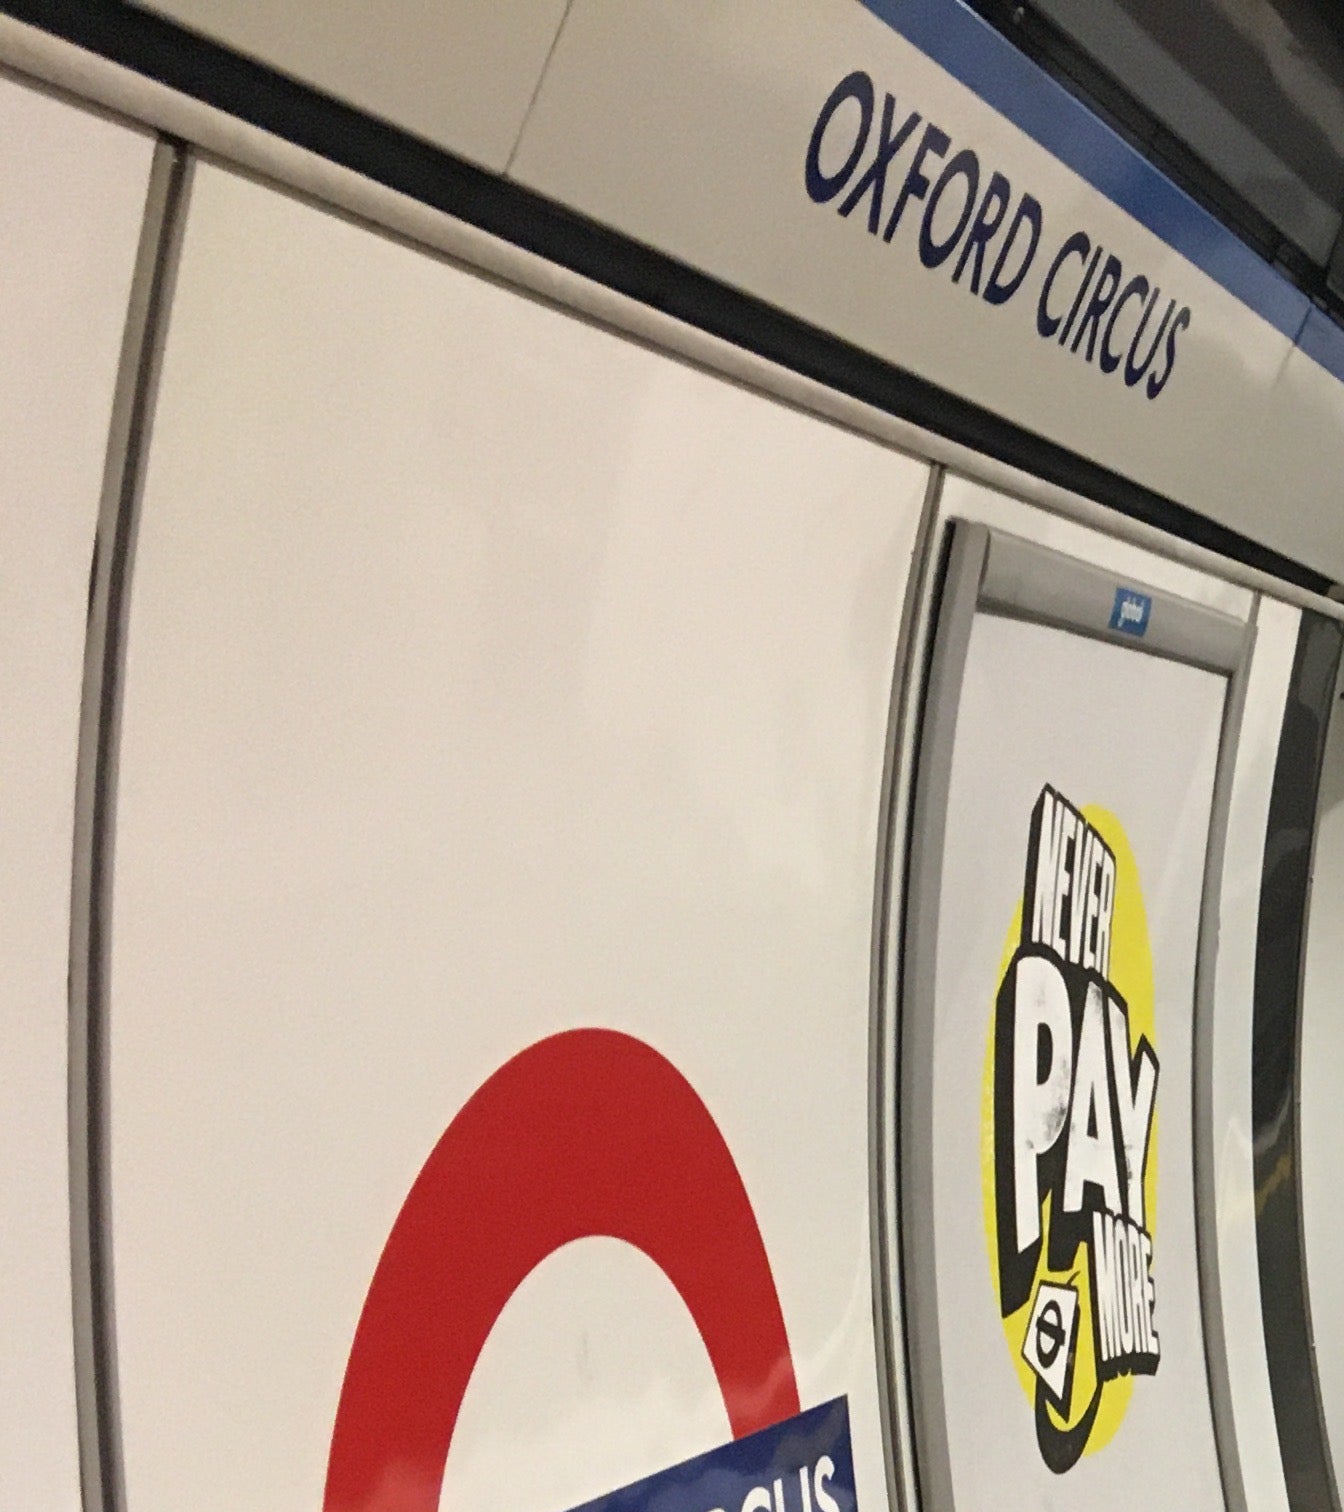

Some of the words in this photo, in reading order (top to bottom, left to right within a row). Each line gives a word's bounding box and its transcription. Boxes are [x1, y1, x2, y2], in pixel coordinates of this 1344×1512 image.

[805, 71, 1042, 305] OXFORD
[1036, 231, 1191, 399] CIRCUS
[1031, 788, 1115, 982] NEVER
[1014, 956, 1158, 1253] PAY
[1092, 1210, 1159, 1362] MORE
